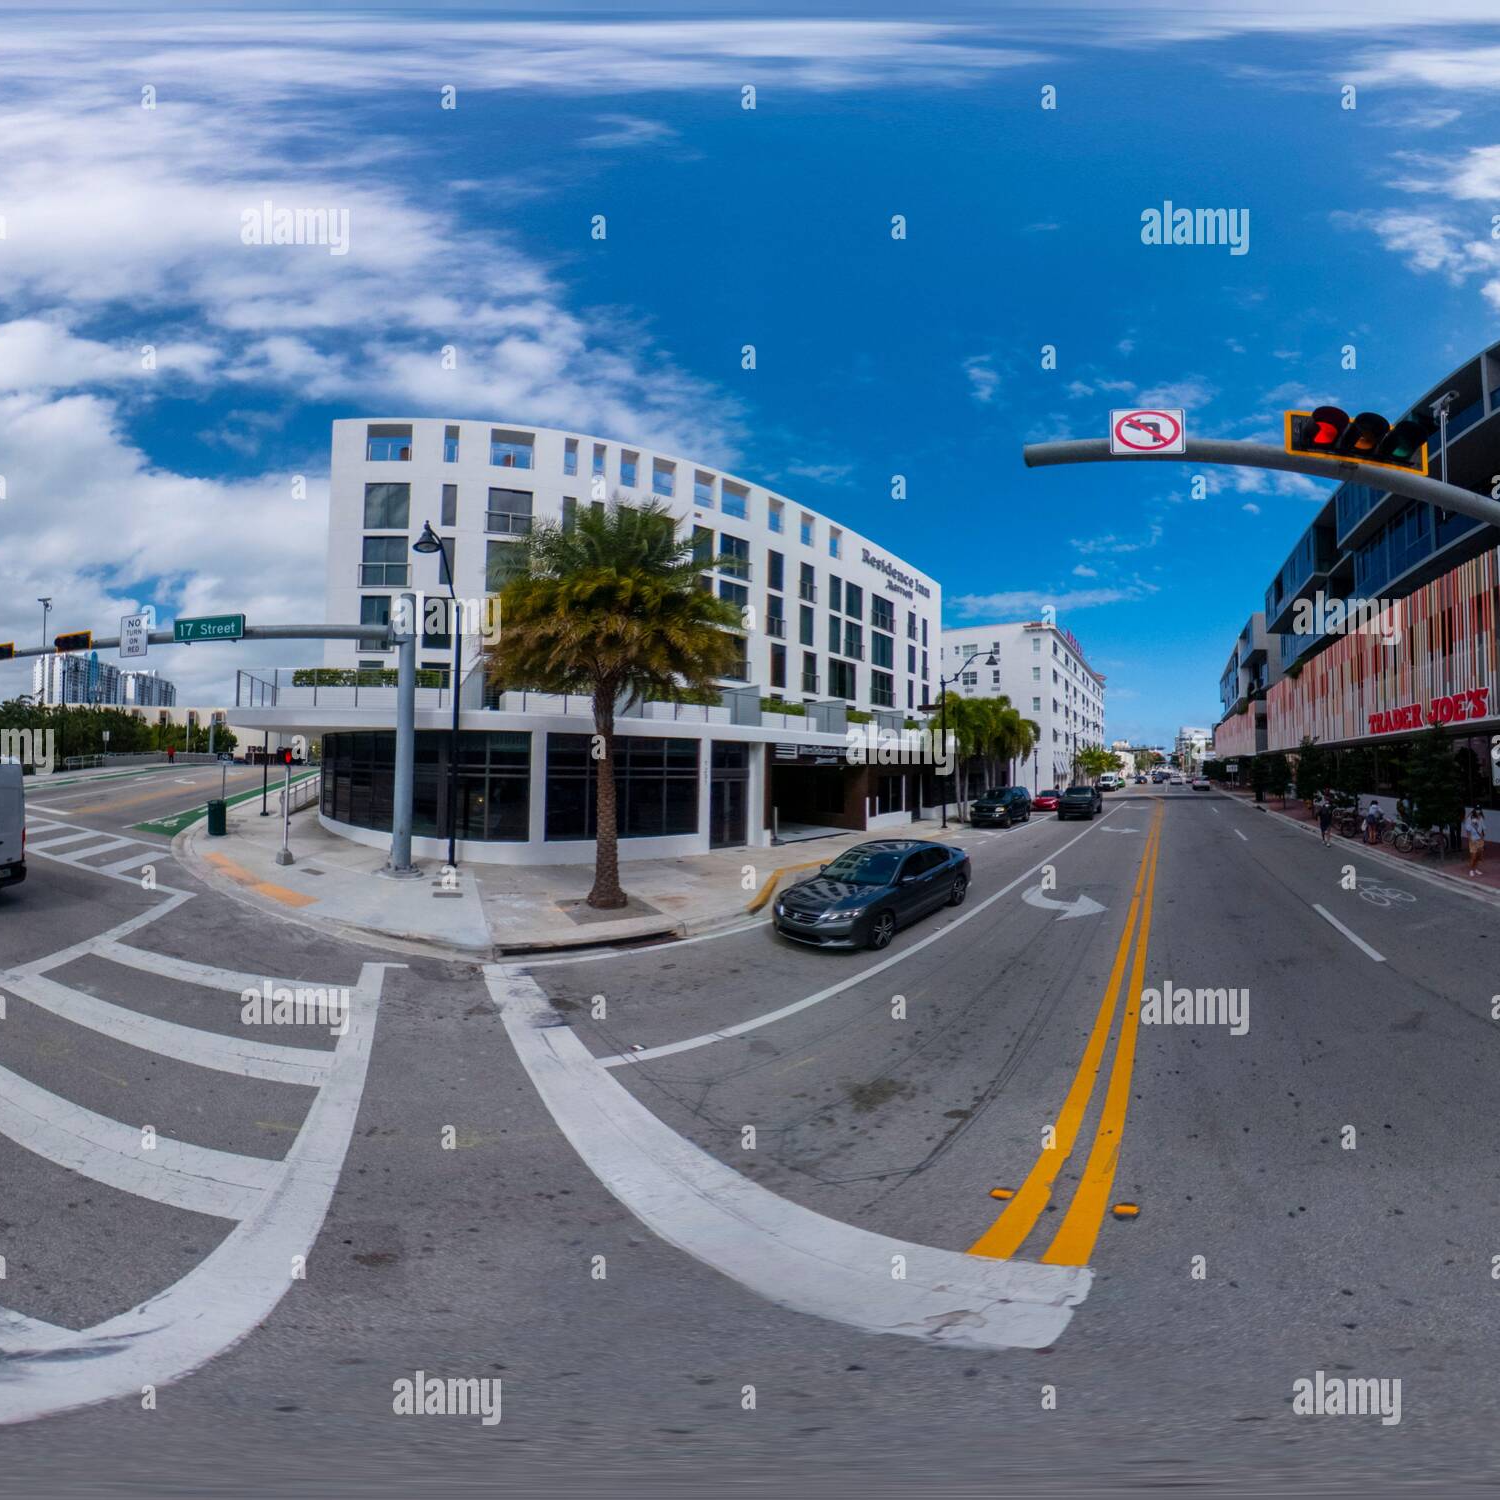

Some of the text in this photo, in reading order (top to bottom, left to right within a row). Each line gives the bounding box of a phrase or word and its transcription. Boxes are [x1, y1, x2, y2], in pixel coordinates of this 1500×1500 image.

[861, 548, 930, 599] Residence Inn
[128, 618, 141, 627] NO
[179, 621, 236, 637] 17 Street
[127, 645, 140, 653] RED
[1368, 687, 1489, 734] TRADER JOE'S
